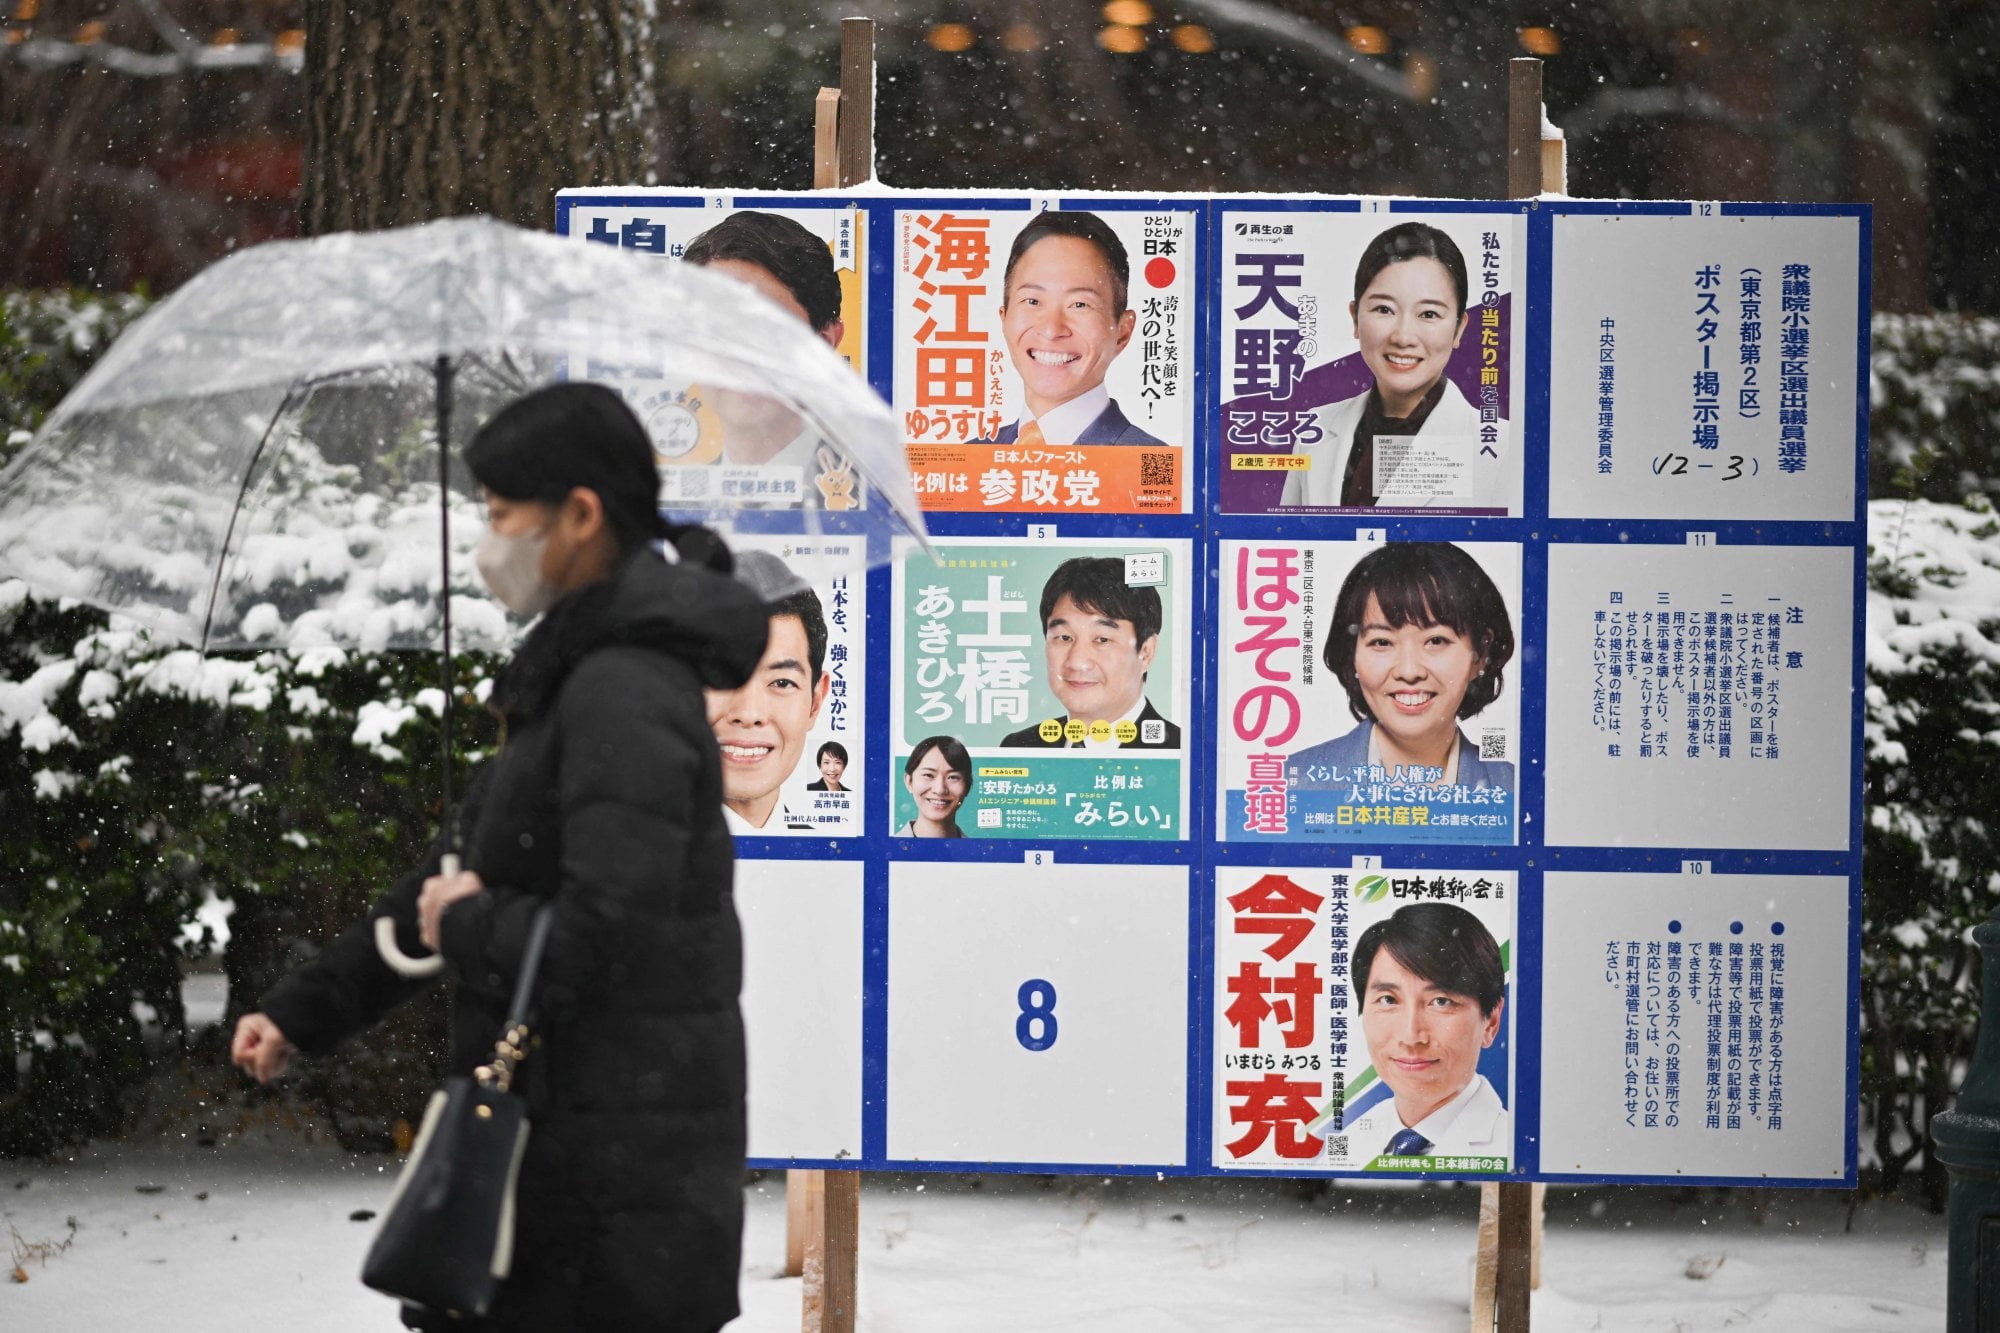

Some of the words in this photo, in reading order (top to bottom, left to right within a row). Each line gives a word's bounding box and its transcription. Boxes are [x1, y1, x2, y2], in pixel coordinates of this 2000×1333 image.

[1041, 200, 1048, 211] 2
[1144, 216, 1172, 226] ひとり
[1144, 227, 1183, 237] ひとりが
[1250, 224, 1294, 235] 再生の道
[1699, 204, 1711, 216] 12
[840, 219, 849, 258] 連合推薦
[1144, 239, 1177, 256] 日本
[912, 213, 991, 408] 海江田
[1233, 253, 1306, 401] 天野
[1296, 294, 1317, 358] あまの
[1163, 296, 1178, 396] 誇りと笑顔を
[1479, 231, 1501, 459] 私たちの当たり前を国会へ
[1692, 264, 1721, 450] ポスター掲示場
[1777, 263, 1811, 473] 衆議院小選挙区選出議員選挙
[990, 350, 1004, 405] かいえだ
[1597, 317, 1615, 475] 中央区選挙管理委員会
[905, 409, 1001, 440] ゆうすけ
[1227, 410, 1325, 446] こころ
[994, 450, 1086, 463] 日本人ファースト
[979, 468, 1100, 506] 参政党
[1038, 527, 1044, 539] 5
[1130, 557, 1157, 565] チーム
[1368, 530, 1374, 541] 4
[1694, 535, 1706, 546] 11
[1003, 590, 1024, 598] どばし
[1130, 569, 1158, 577] みらい
[915, 584, 956, 723] あきひろ
[954, 575, 1032, 724] 土橋
[1592, 610, 1607, 731] 車しないでください。
[1625, 611, 1638, 681] せられます。
[1671, 612, 1685, 694] 用できません。
[1735, 613, 1748, 708] はってください。
[1639, 612, 1654, 758] ターを破ったりすると罰
[1686, 612, 1701, 758] このポスター掲示場を使
[1702, 612, 1717, 751] 選挙候補者以外の方は、
[1750, 613, 1764, 758] 定された番号の区画に
[983, 780, 1057, 795] 安野たかひろ
[1093, 775, 1143, 790] 比例は
[1306, 764, 1443, 783] くらし、平和、人権が
[1346, 784, 1507, 804] 大事にされる社会を
[814, 800, 850, 809] 高市早苗
[1035, 854, 1042, 865] 8
[1363, 857, 1371, 869] 7
[1391, 876, 1493, 902] 日本維新の会
[1690, 863, 1702, 875] 10
[1224, 873, 1325, 1049] 今村
[1606, 940, 1620, 990] ださい。
[1687, 942, 1701, 1005] できます。
[1016, 978, 1058, 1051] 8
[1624, 940, 1641, 1128] 市町村選管にお問い合わせく
[1645, 941, 1661, 1128] 対応については、お住いの区
[1665, 941, 1682, 1128] 障害のある方への投票所での
[1706, 942, 1722, 1129] 難な方は代理投票制度が利用
[1727, 942, 1743, 1130] 障害等で投票用紙の記載が困
[1748, 943, 1763, 1121] 投票用紙で投票ができます。
[1767, 943, 1784, 1130] 視覚に障害がある方は点字用
[1225, 1054, 1276, 1070] いまむら
[1281, 1054, 1322, 1070] みつる
[1224, 1072, 1325, 1159] 充
